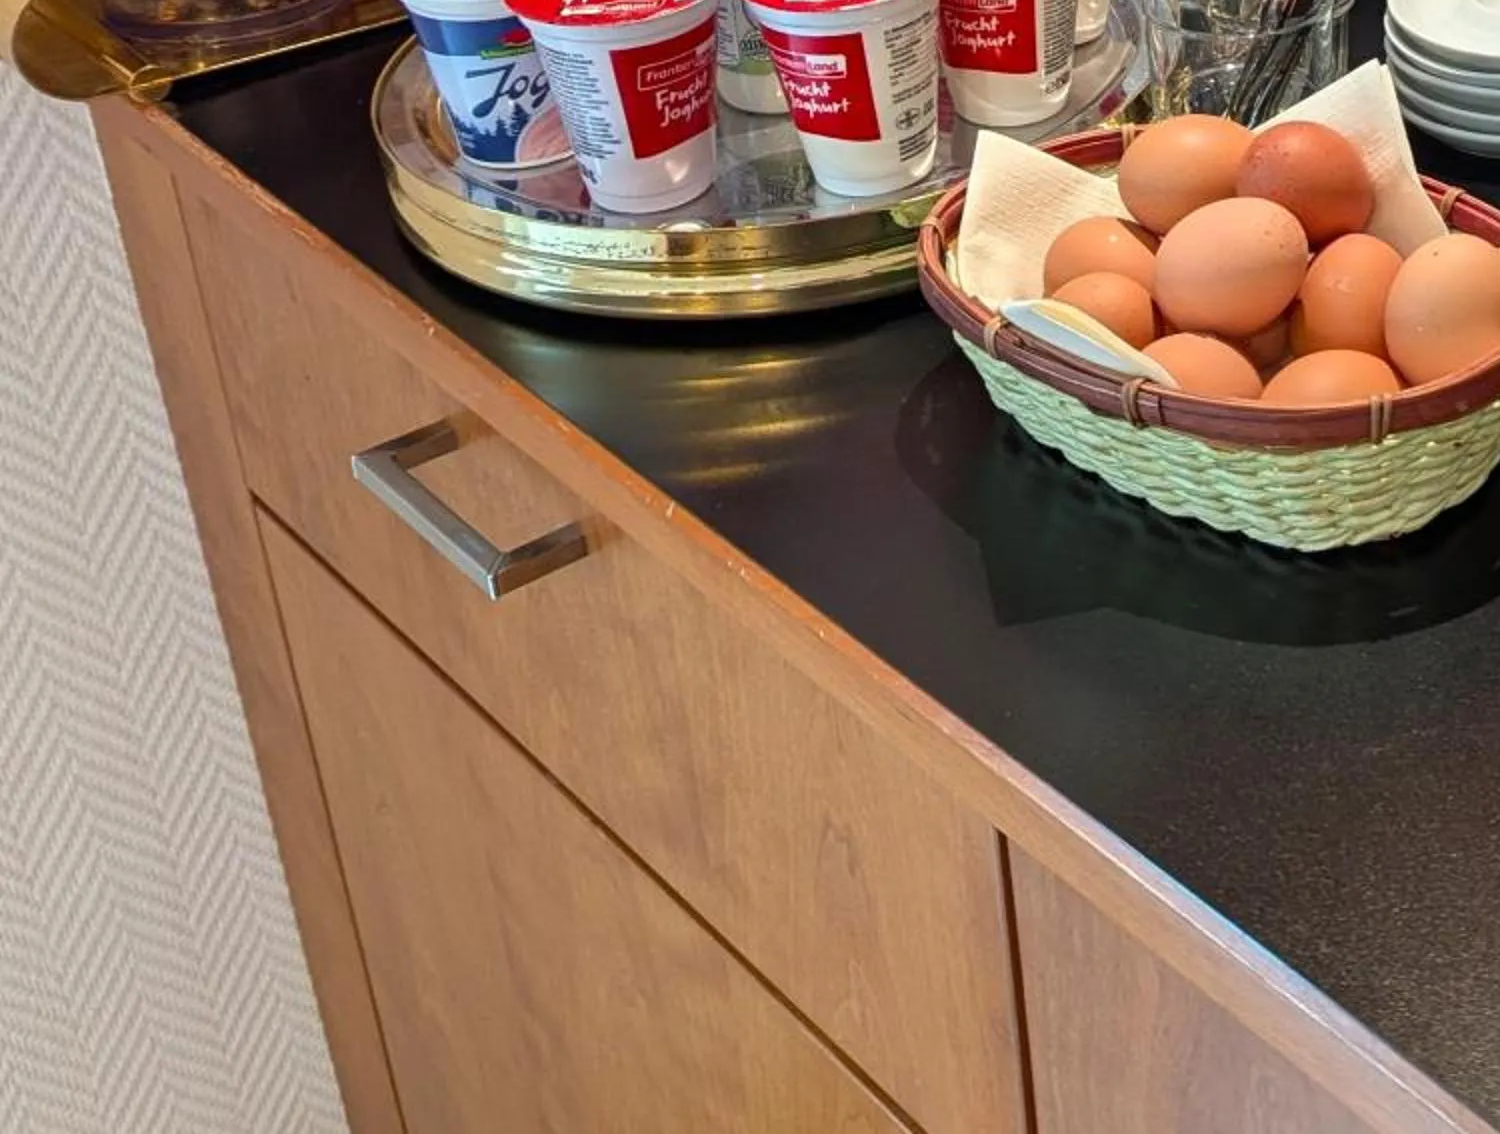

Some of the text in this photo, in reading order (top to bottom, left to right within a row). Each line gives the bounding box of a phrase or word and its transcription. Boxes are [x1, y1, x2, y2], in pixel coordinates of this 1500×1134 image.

[944, 10, 999, 32] Frucht
[655, 69, 708, 112] Frucht
[659, 88, 713, 127] Joghu
